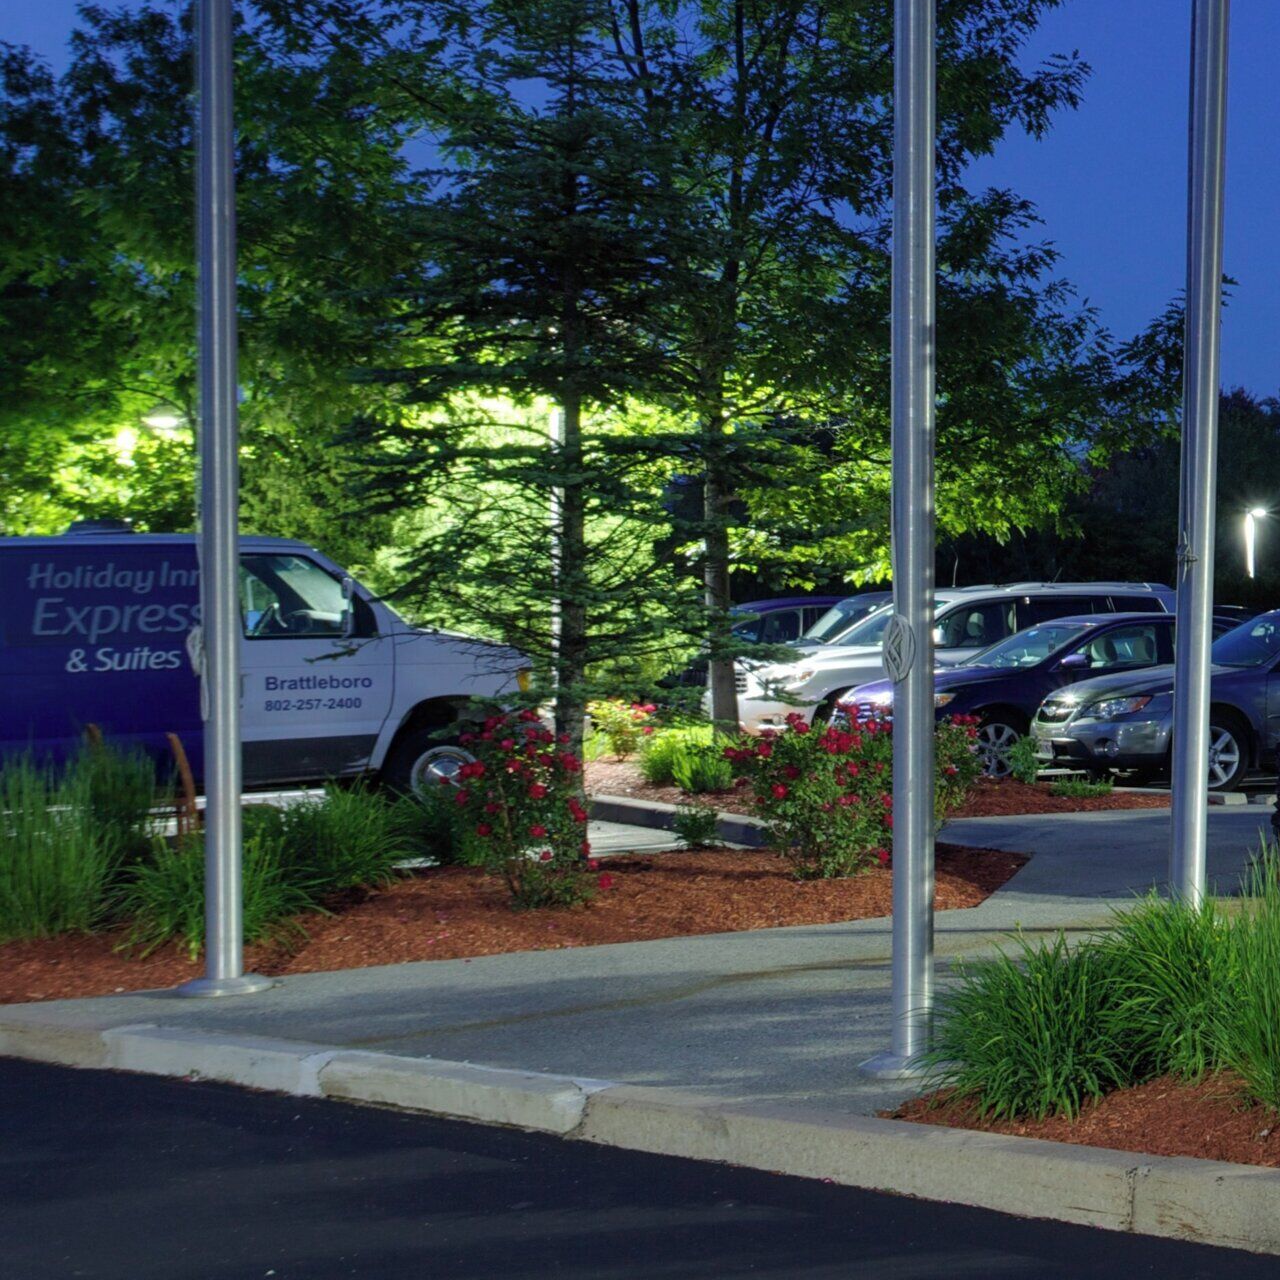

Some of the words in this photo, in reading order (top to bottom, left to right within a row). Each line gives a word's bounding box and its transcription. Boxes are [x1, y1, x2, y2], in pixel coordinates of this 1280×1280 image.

[27, 562, 154, 593] Holiday
[65, 648, 88, 672] &
[94, 646, 182, 671] Suites
[265, 675, 373, 691] Brattleboro
[264, 697, 363, 712] 802-257-2400
